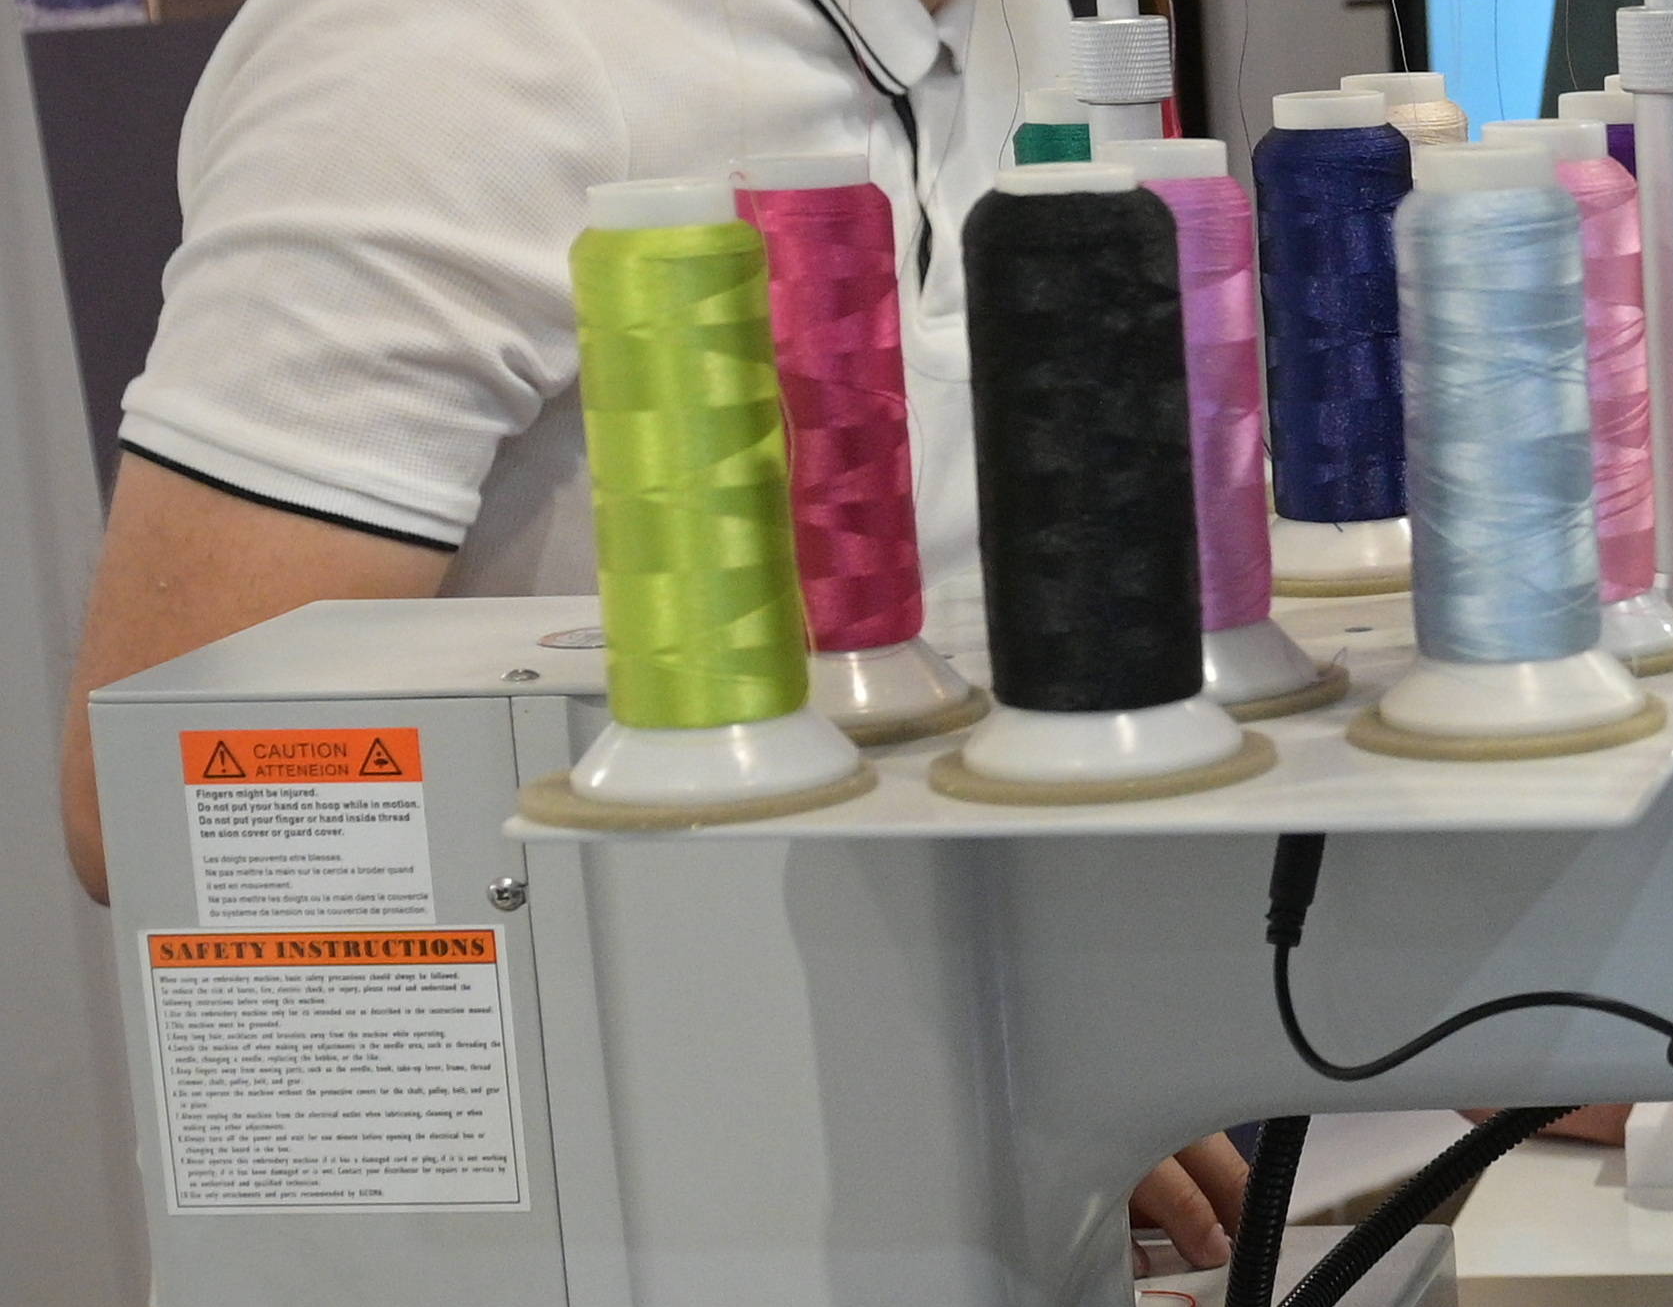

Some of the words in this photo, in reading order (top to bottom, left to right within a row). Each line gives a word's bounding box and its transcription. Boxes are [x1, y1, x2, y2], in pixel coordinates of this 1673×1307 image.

[252, 741, 348, 760] CAUTION
[254, 762, 350, 778] ATTENEION
[195, 788, 234, 801] Fingers
[234, 787, 264, 800] might
[264, 787, 278, 798] be
[279, 787, 318, 800] injured.
[196, 801, 211, 812] Do
[212, 802, 229, 812] not
[230, 801, 248, 814] put
[248, 802, 272, 813] your
[272, 800, 299, 811] hand
[299, 802, 313, 810] on
[314, 799, 341, 812] hoop
[342, 799, 369, 809] while
[370, 799, 380, 809] in
[197, 814, 213, 825] Do
[213, 815, 231, 825] not
[232, 815, 249, 826] put
[250, 815, 274, 827] your
[274, 813, 305, 826] finger
[305, 815, 318, 824] or
[318, 812, 344, 823] hand
[345, 812, 376, 823] inside
[240, 829, 270, 838] cover
[270, 828, 282, 837] or
[282, 826, 313, 839] guard
[313, 827, 344, 837] cover.
[160, 941, 264, 961] SAFETY
[276, 937, 486, 959] INSTRUCTIONS
